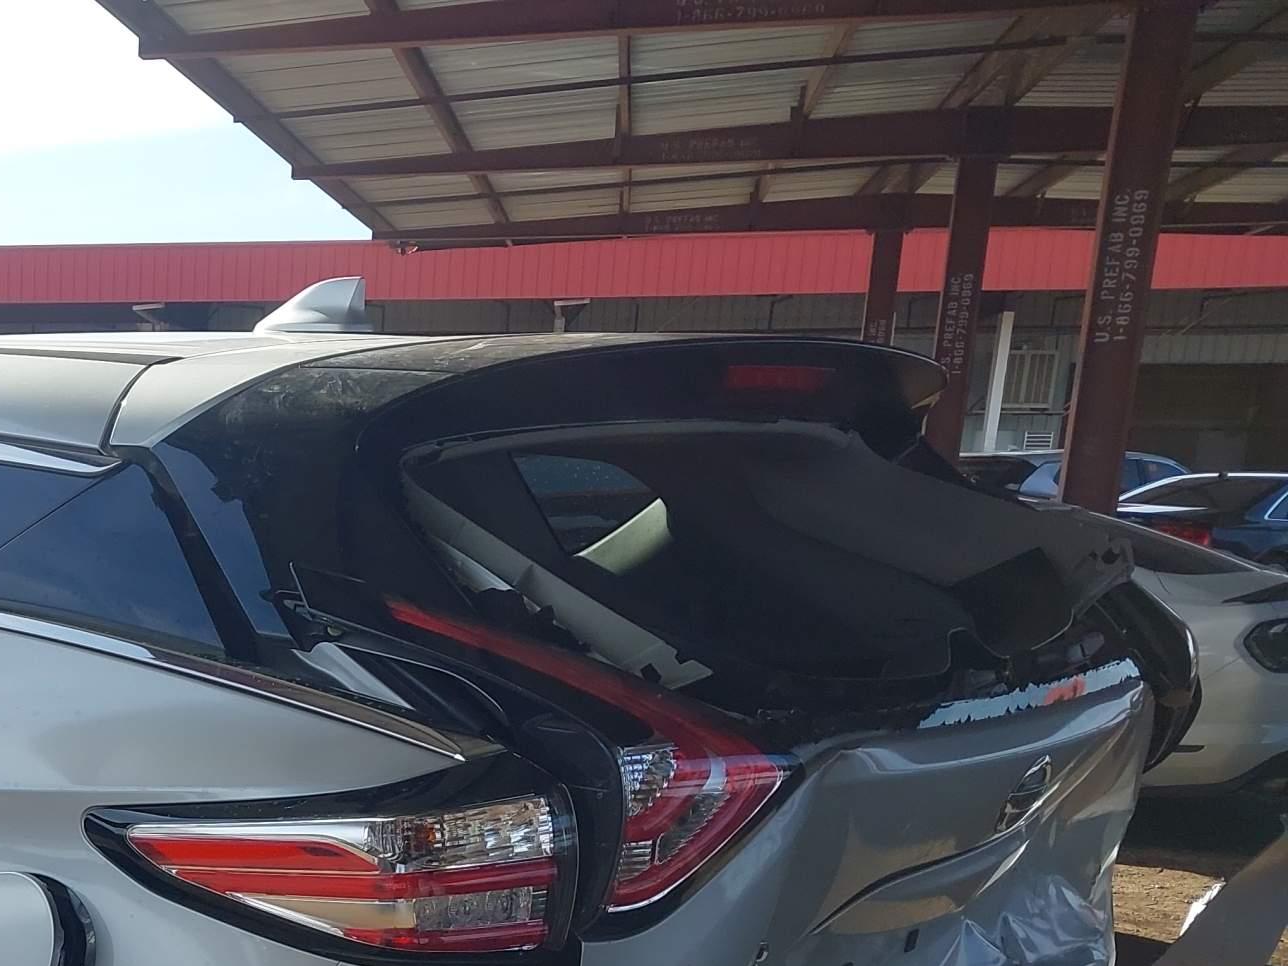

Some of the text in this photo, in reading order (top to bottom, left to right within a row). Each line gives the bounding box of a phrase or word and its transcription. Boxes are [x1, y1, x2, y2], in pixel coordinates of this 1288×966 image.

[943, 301, 959, 348] PREFAB
[1095, 188, 1131, 343] U.S. PREFAB INC.
[1113, 189, 1149, 341] 1-866-799-0869
